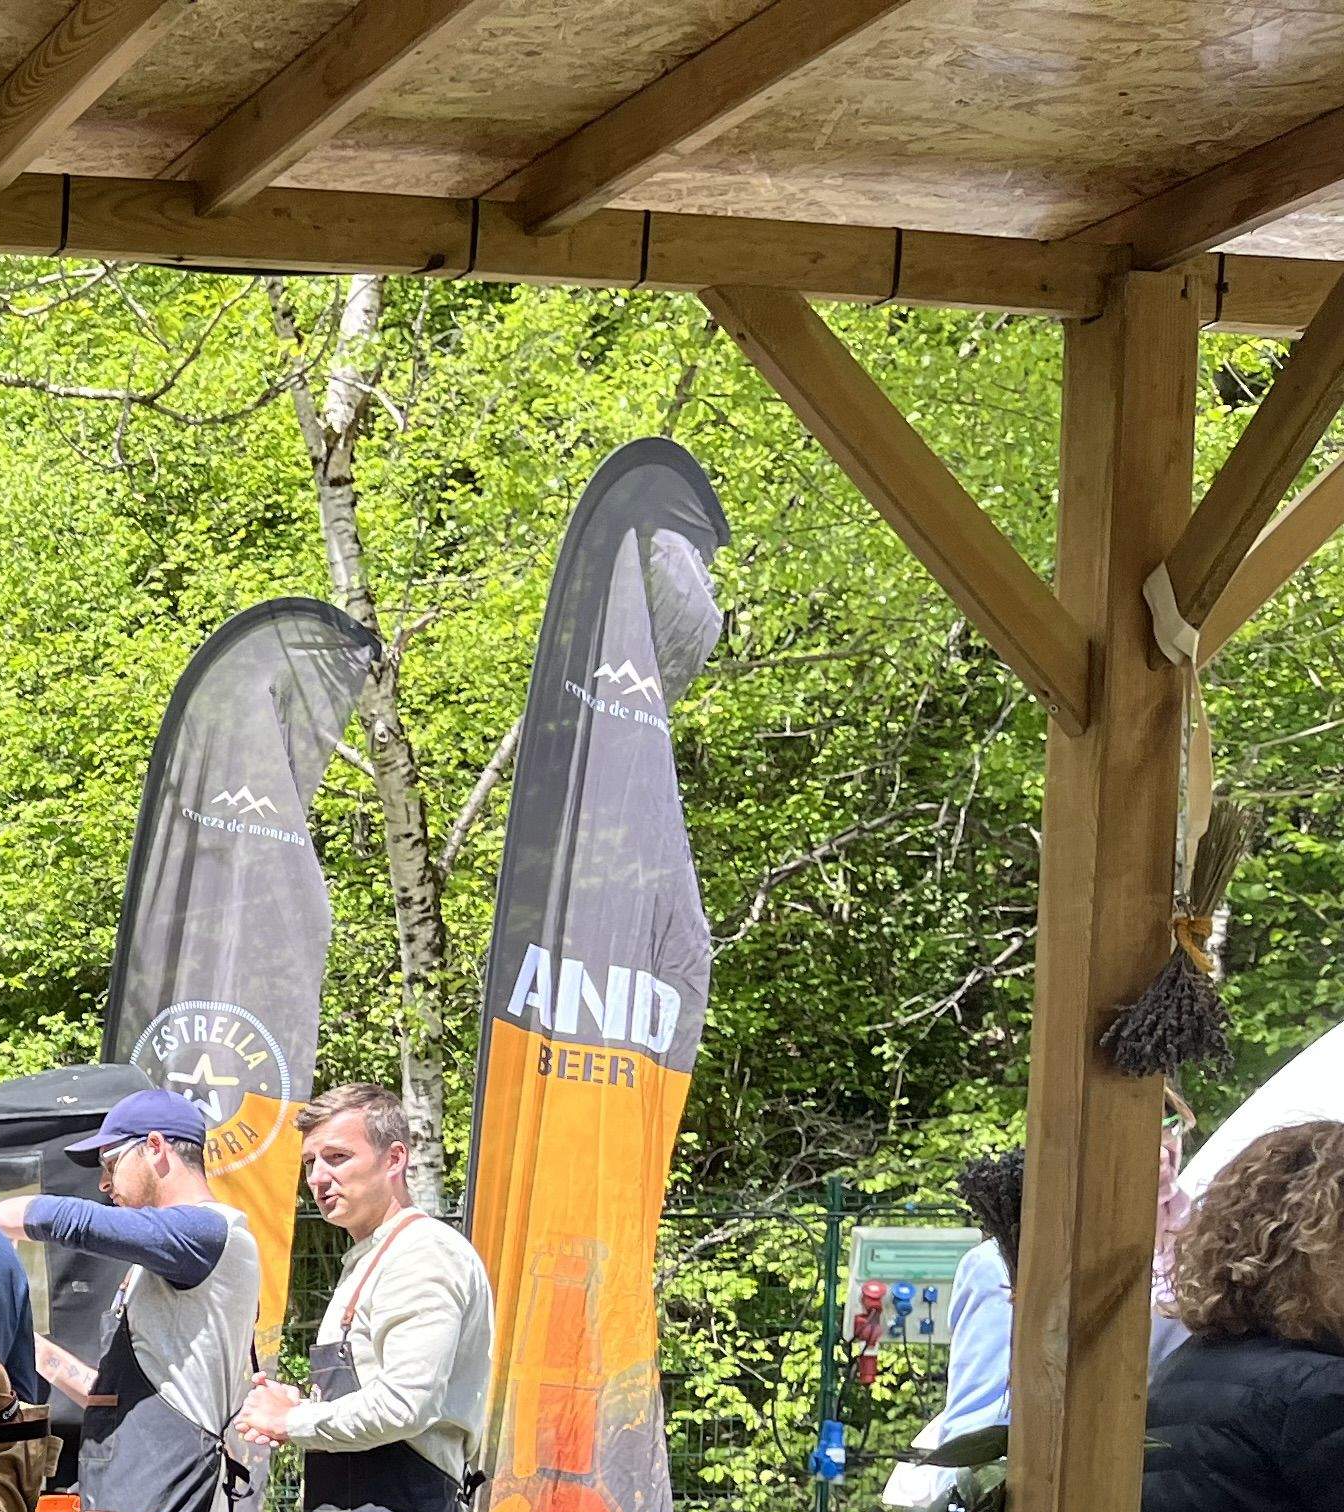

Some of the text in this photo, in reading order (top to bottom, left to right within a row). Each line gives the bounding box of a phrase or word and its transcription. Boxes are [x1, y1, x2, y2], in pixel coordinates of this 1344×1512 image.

[507, 943, 682, 1054] AND
[151, 1013, 269, 1072] ESTRELLA
[538, 1041, 636, 1089] BEER
